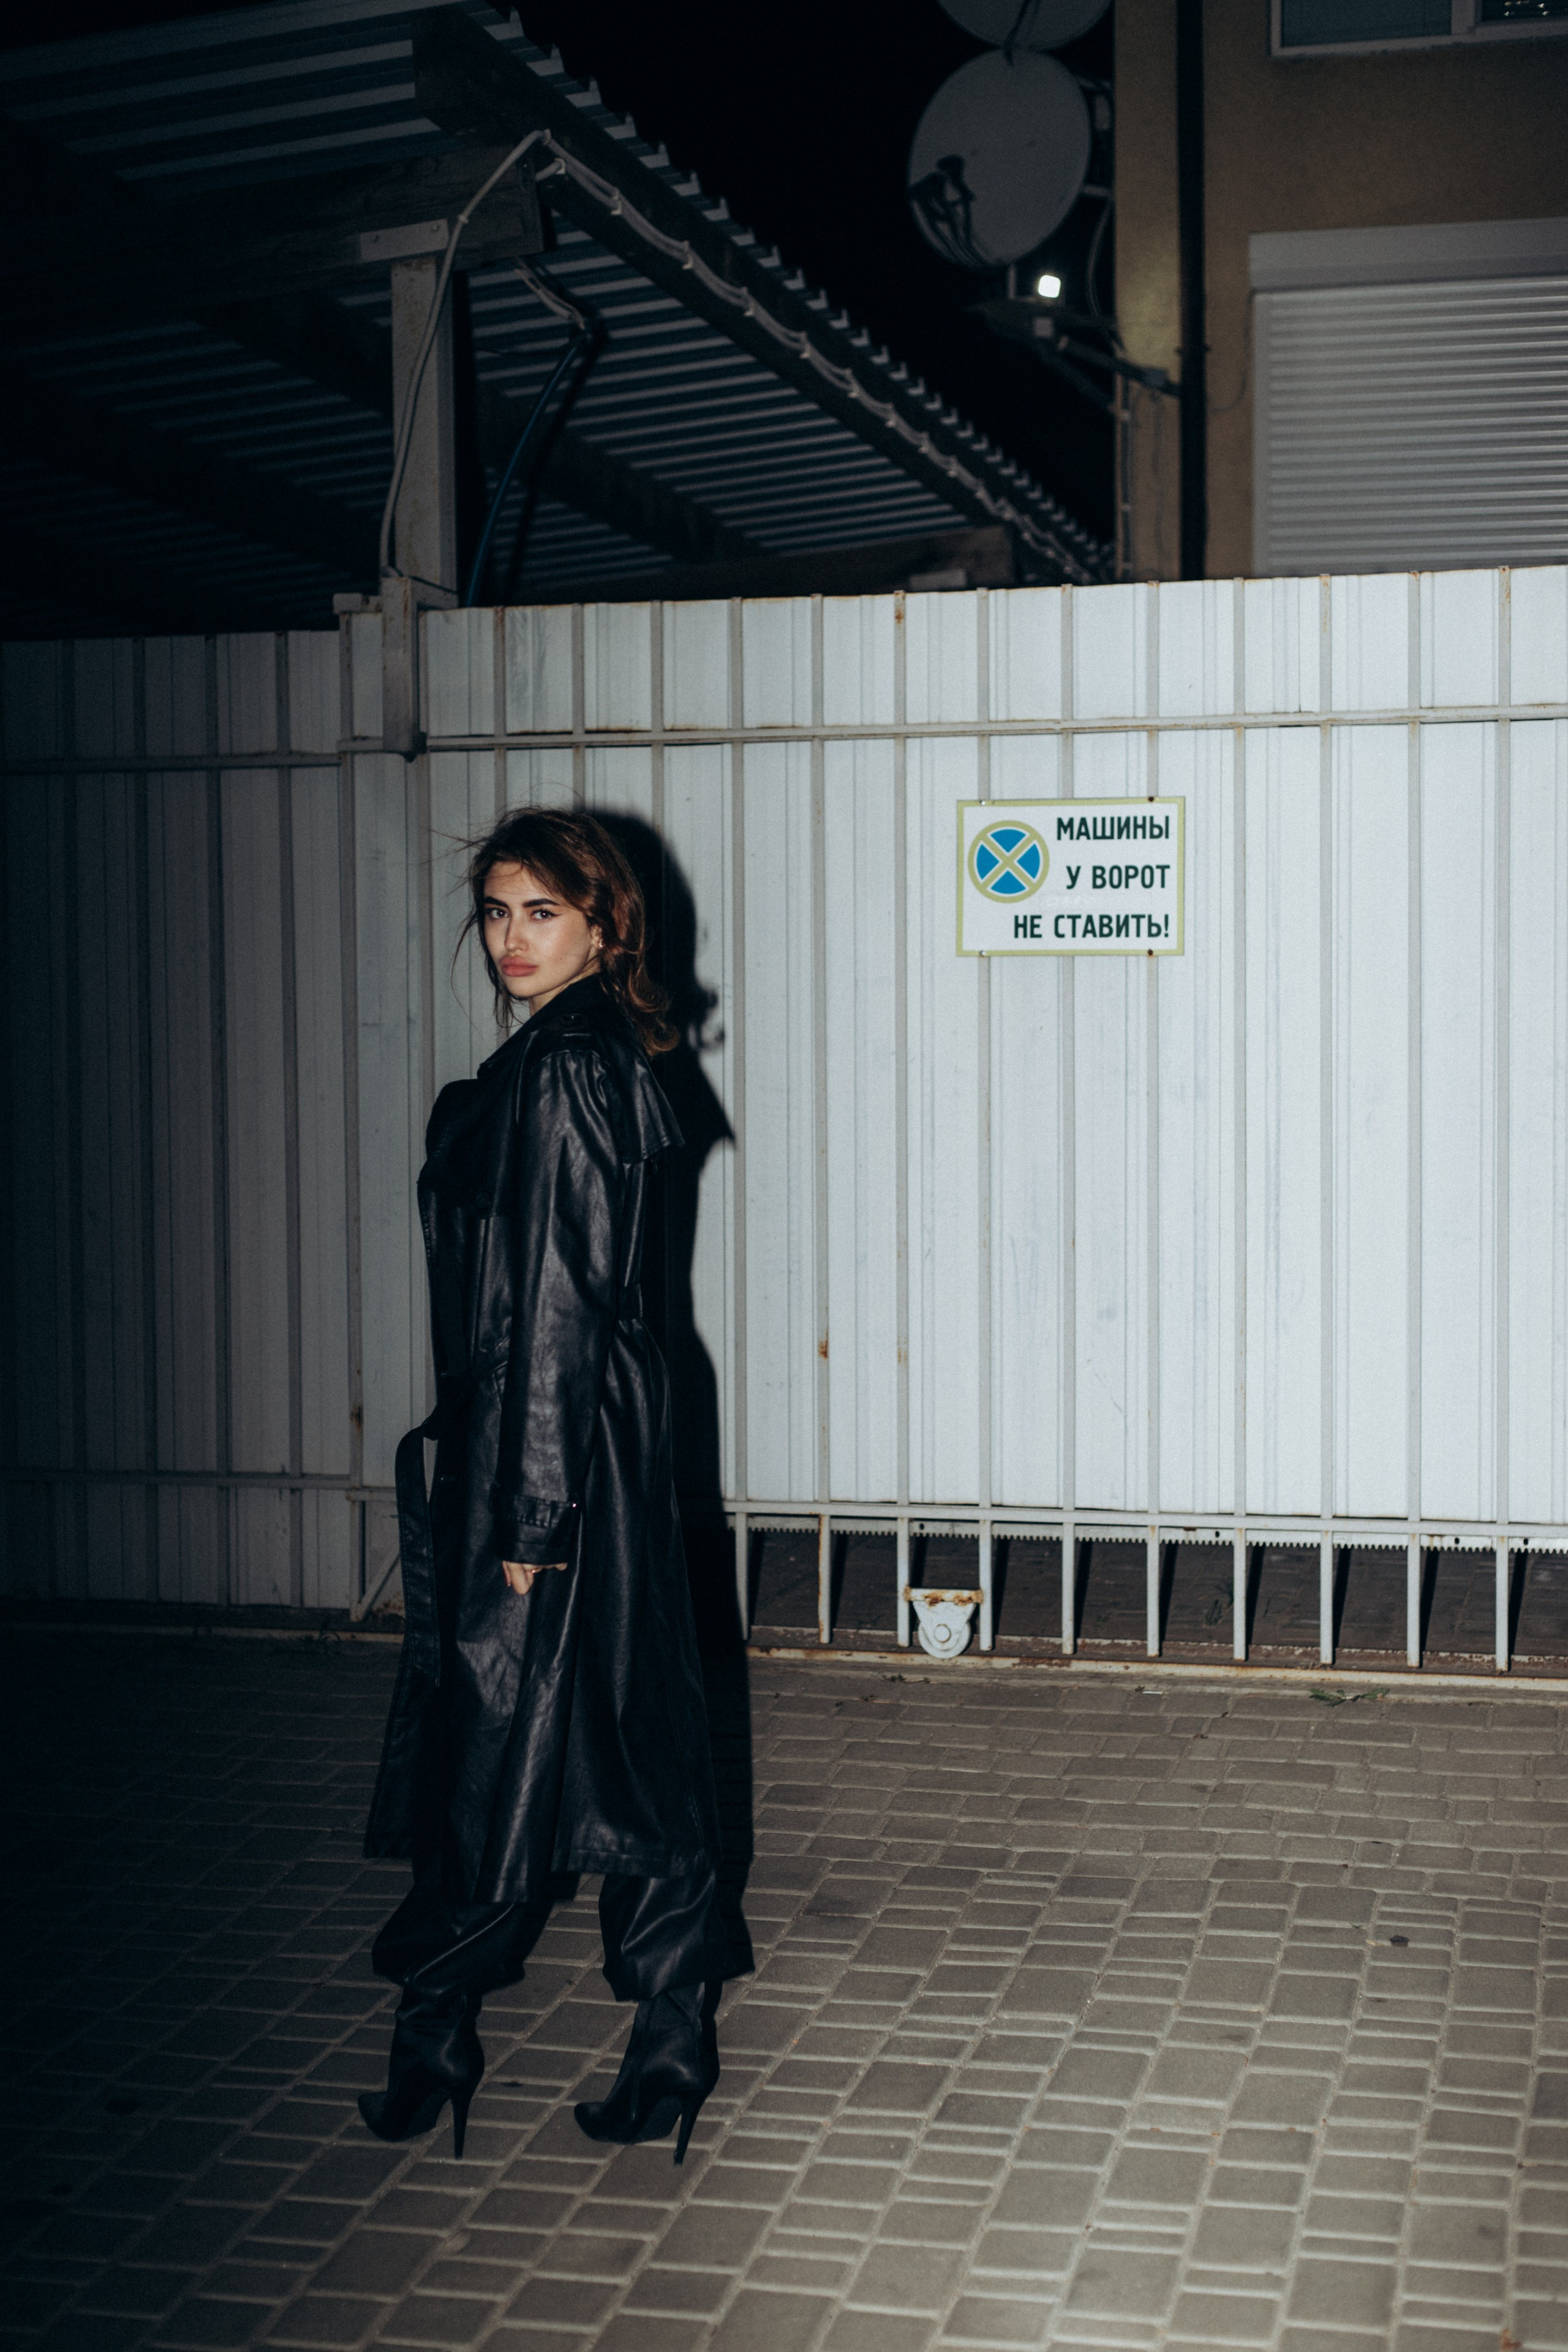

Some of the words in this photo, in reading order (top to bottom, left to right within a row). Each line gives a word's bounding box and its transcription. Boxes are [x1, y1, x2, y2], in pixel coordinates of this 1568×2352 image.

[1057, 816, 1169, 840] МАШИНЫ
[1066, 865, 1081, 889] У
[1092, 865, 1170, 889] ВОРОТ
[1014, 914, 1042, 938] НЕ
[1054, 914, 1169, 938] СТАВИТЬ!
